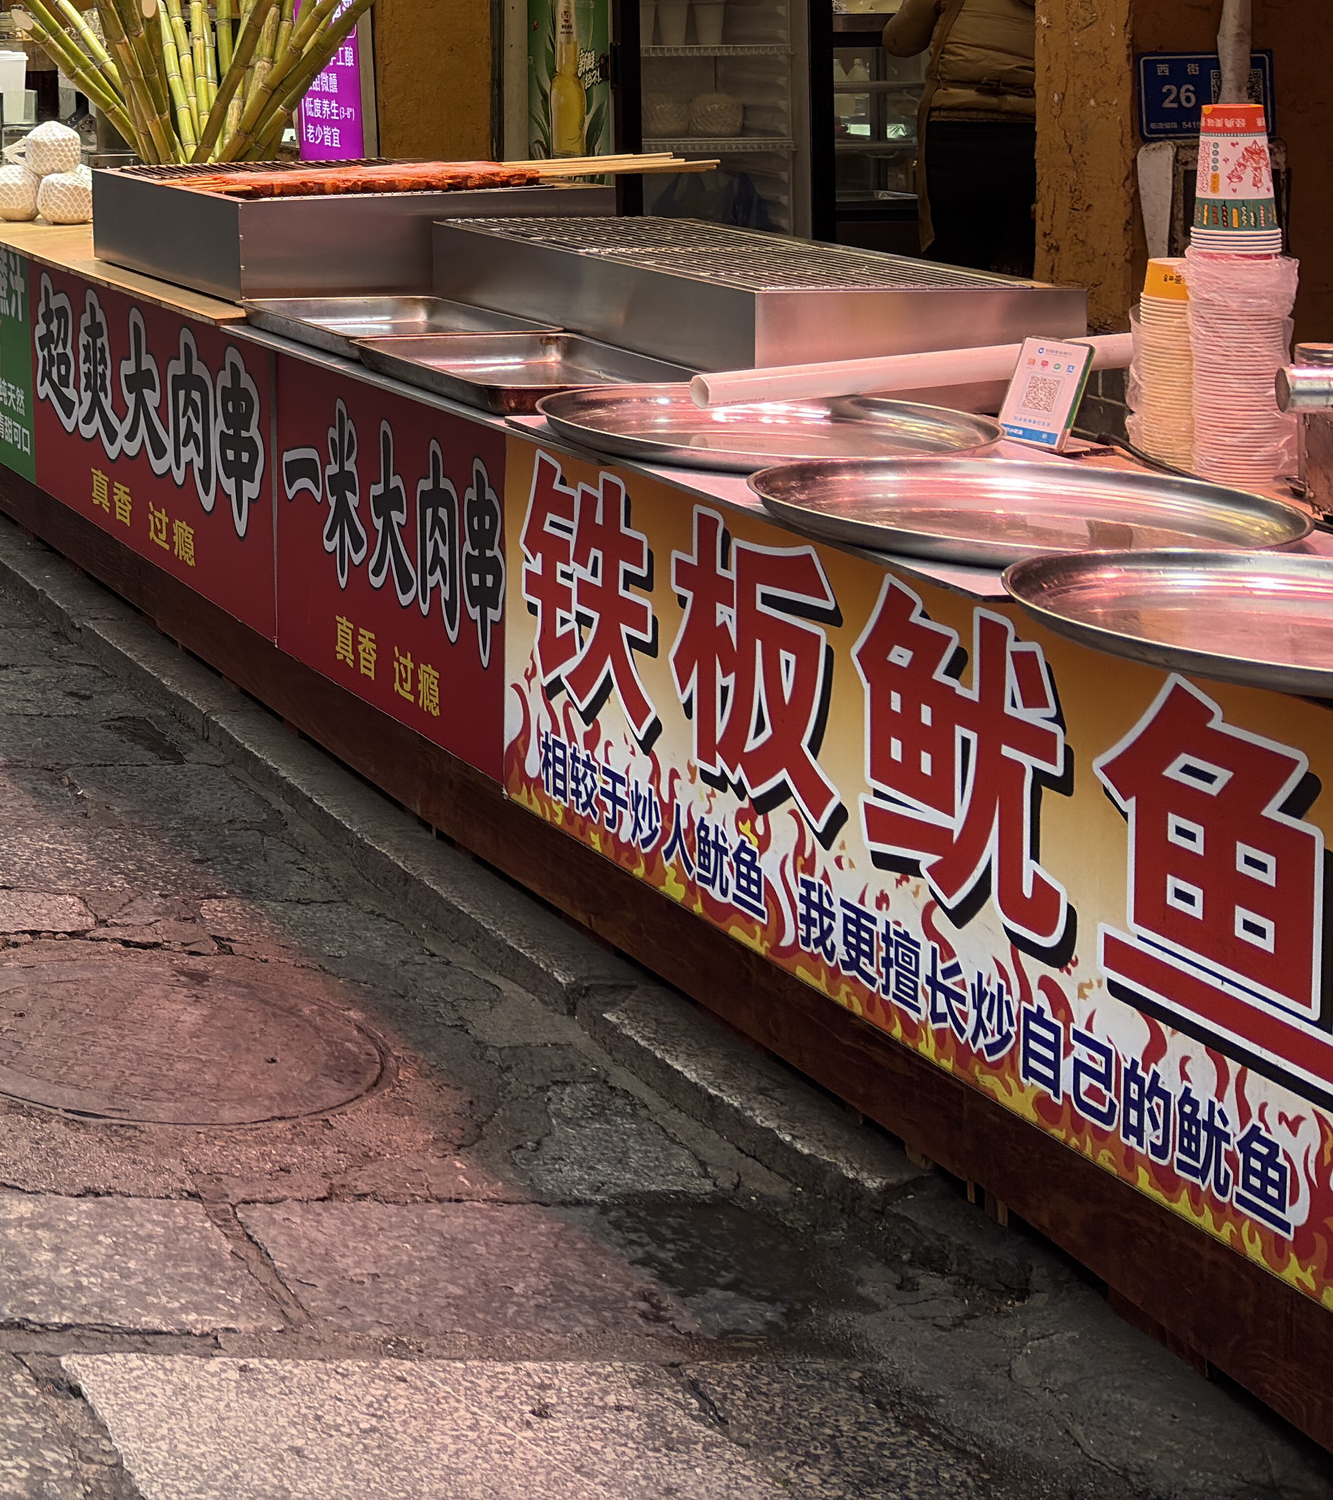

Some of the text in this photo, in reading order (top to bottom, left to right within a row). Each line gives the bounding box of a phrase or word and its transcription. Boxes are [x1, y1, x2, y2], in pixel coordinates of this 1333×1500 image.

[305, 97, 339, 120] 低度养生
[1156, 63, 1200, 76] 西街
[1162, 84, 1197, 109] 26
[306, 123, 341, 148] 老少皆宜
[36, 272, 266, 540] 超爽大肉串
[91, 468, 196, 568] 真香 过瘾
[282, 398, 505, 669] 一米大肉串
[335, 615, 440, 717] 真香 过瘾
[520, 450, 1333, 1100] 铁板鱿鱼
[540, 730, 1293, 1242] 相较于炒人鱿鱼 我更擅长炒自己的鱿鱼
